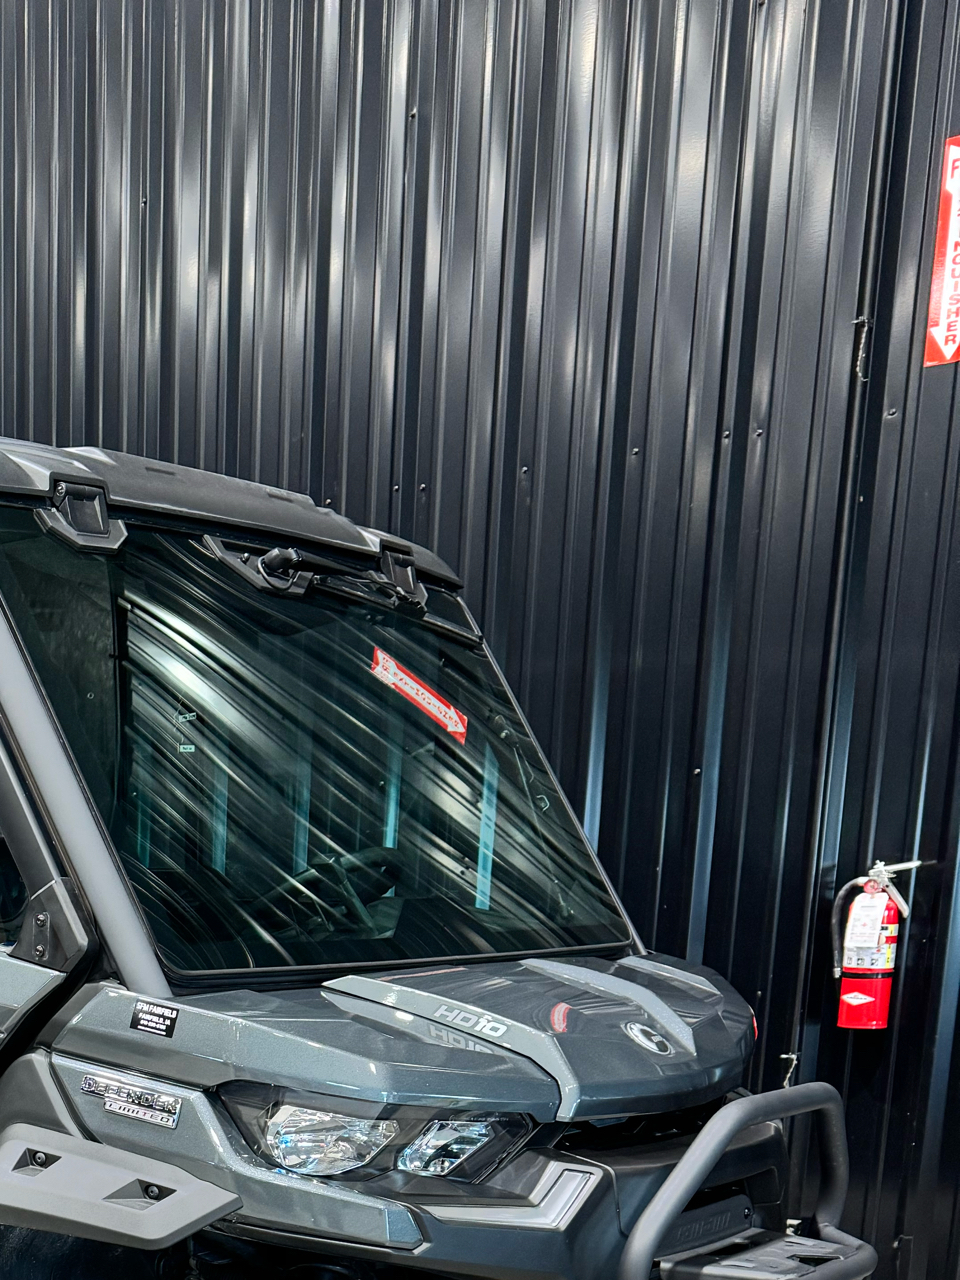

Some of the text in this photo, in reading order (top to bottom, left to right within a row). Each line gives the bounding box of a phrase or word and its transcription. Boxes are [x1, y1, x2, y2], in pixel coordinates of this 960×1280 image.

[149, 1004, 178, 1019] FAIRFIELD
[433, 1004, 508, 1037] HD10
[83, 1075, 178, 1113] DEFENDER
[108, 1102, 170, 1123] LIMITED
